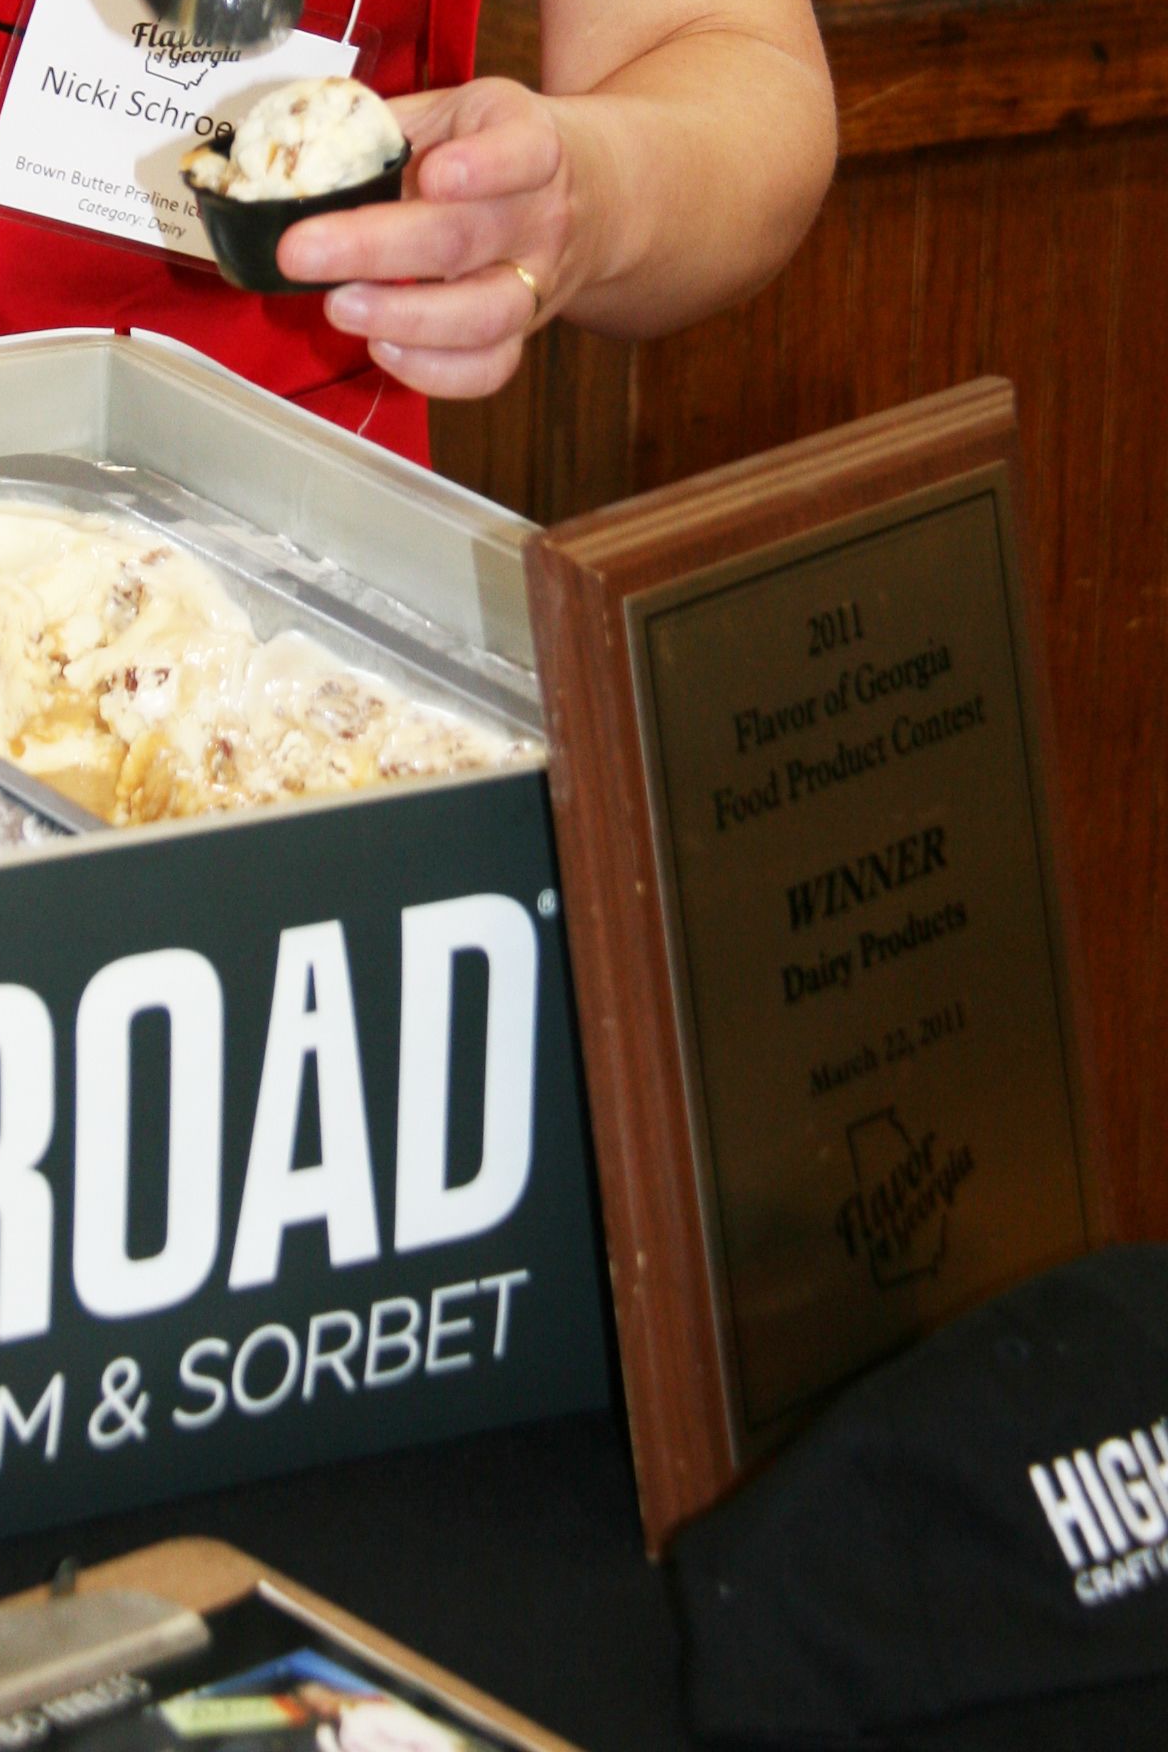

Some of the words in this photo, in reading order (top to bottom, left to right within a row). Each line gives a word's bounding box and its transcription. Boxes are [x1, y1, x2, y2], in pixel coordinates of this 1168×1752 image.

[41, 66, 120, 111] Nicki
[125, 90, 236, 140] Schroe
[153, 48, 167, 64] of
[168, 45, 242, 69] Georgia
[15, 155, 67, 181] Brown
[70, 170, 122, 196] Butter
[124, 185, 180, 212] Praline
[183, 200, 201, 218] Ic
[78, 197, 143, 227] Category:
[147, 215, 187, 240] Dairy
[807, 601, 864, 658] 2011
[733, 696, 817, 754] Flavor
[823, 670, 849, 718] of
[854, 637, 952, 704] Georgia
[712, 767, 781, 832] Food
[786, 734, 887, 802] Product
[891, 694, 986, 756] Contest
[785, 824, 948, 934] WINNER
[780, 950, 852, 1005] Dairy
[859, 899, 968, 969] Products
[808, 1044, 880, 1098] March
[918, 999, 966, 1047] 2011
[87, 1355, 150, 1450] &
[172, 1268, 531, 1430] SORBET
[1028, 1421, 1168, 1570] HIGH
